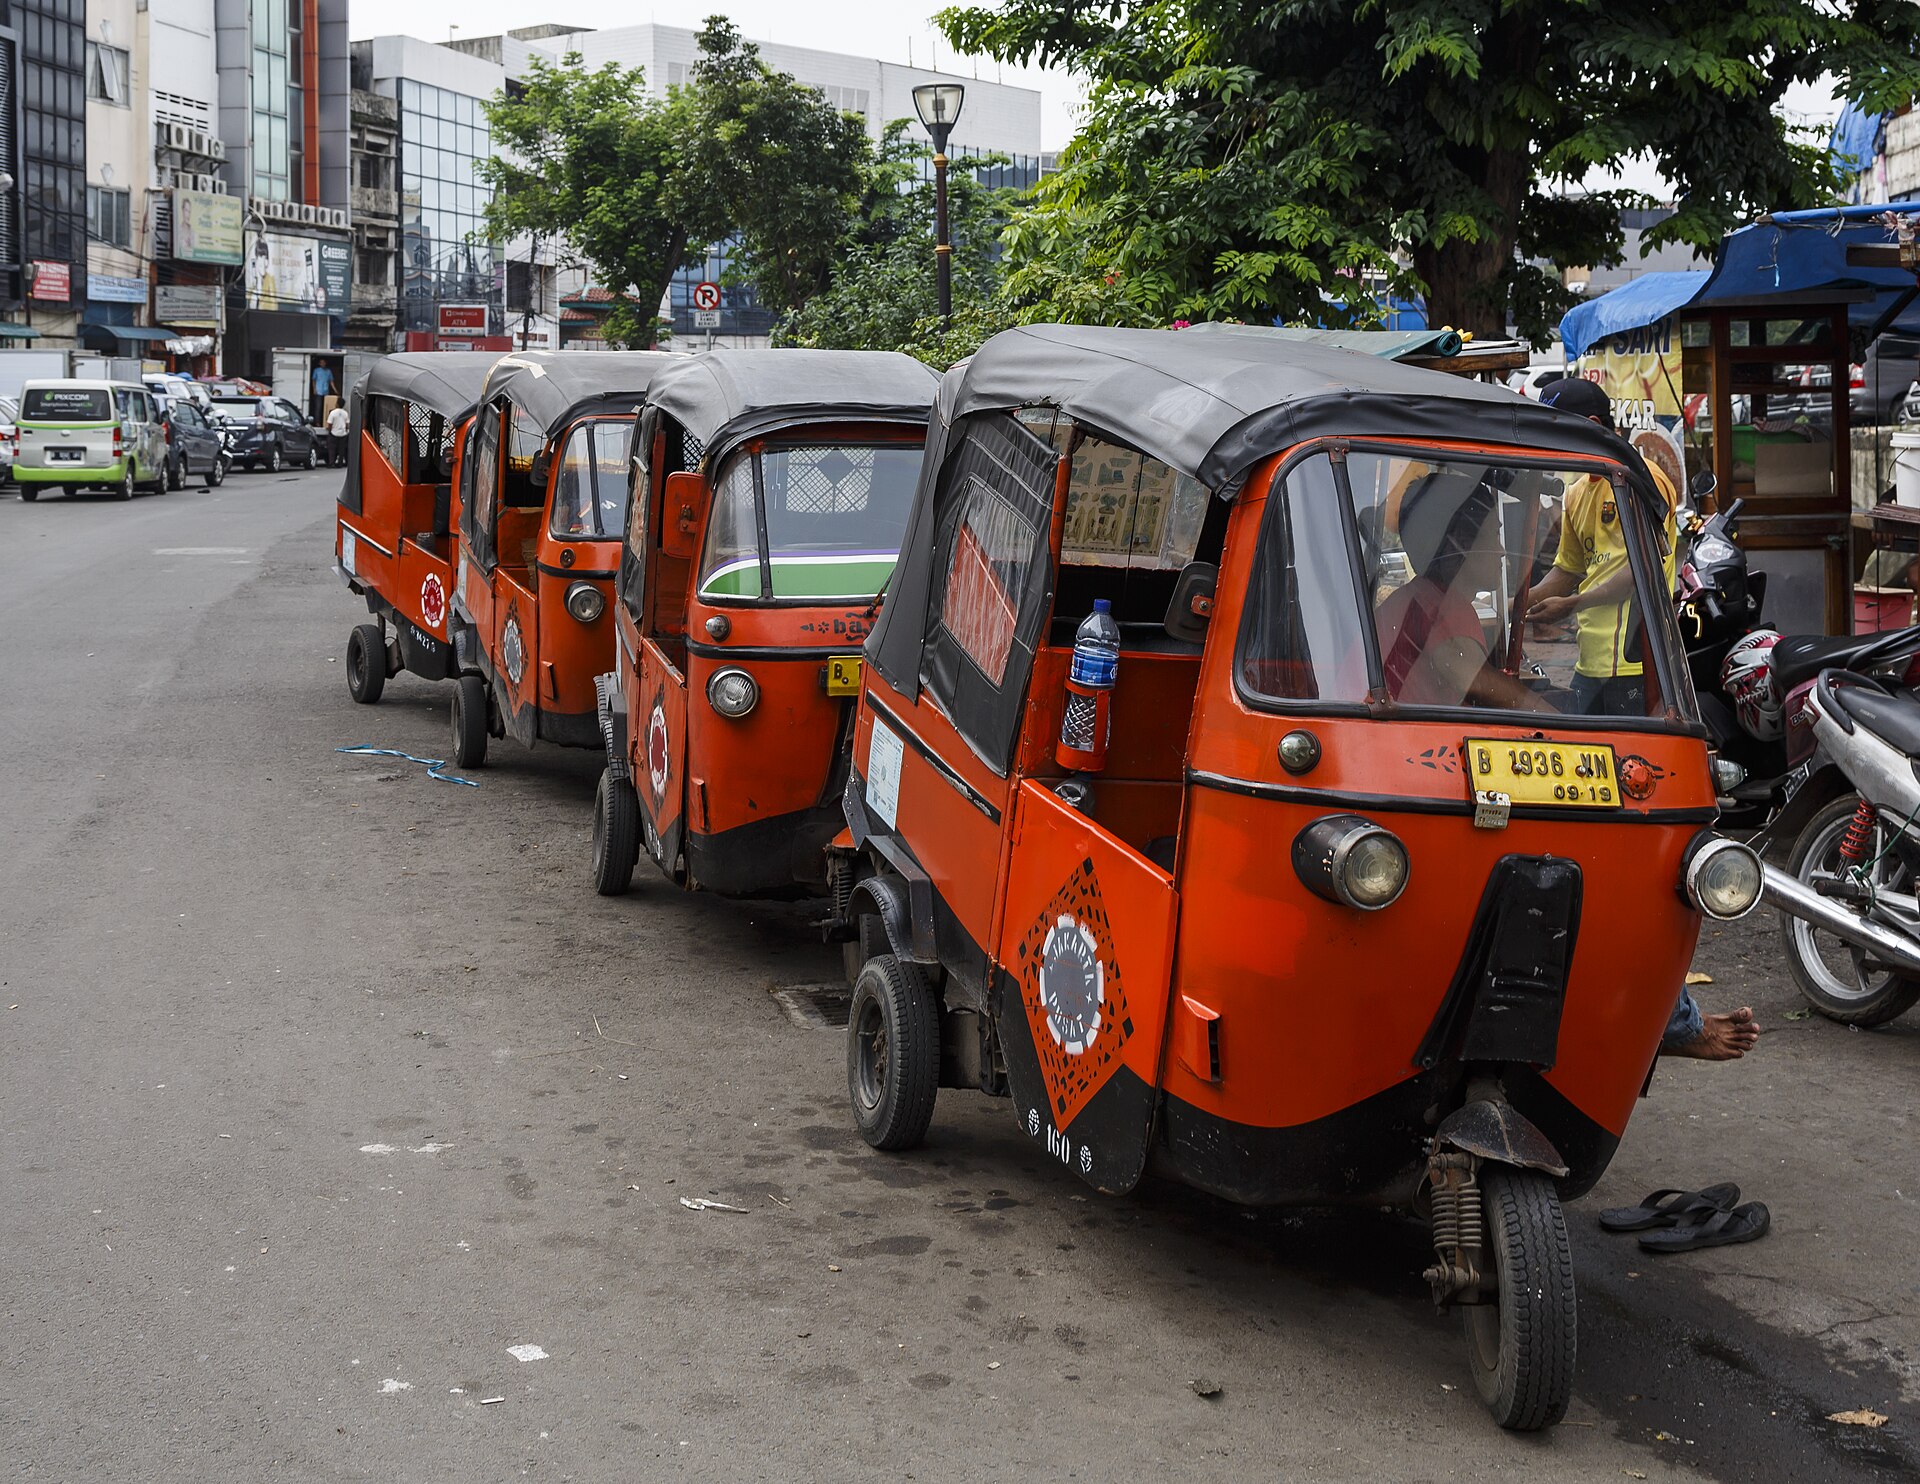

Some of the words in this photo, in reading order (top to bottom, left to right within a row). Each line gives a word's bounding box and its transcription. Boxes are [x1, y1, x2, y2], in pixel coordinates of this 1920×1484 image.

[451, 319, 467, 327] ATM
[1477, 747, 1492, 775] B
[1508, 749, 1564, 777] 1936
[1046, 1122, 1071, 1165] 160
